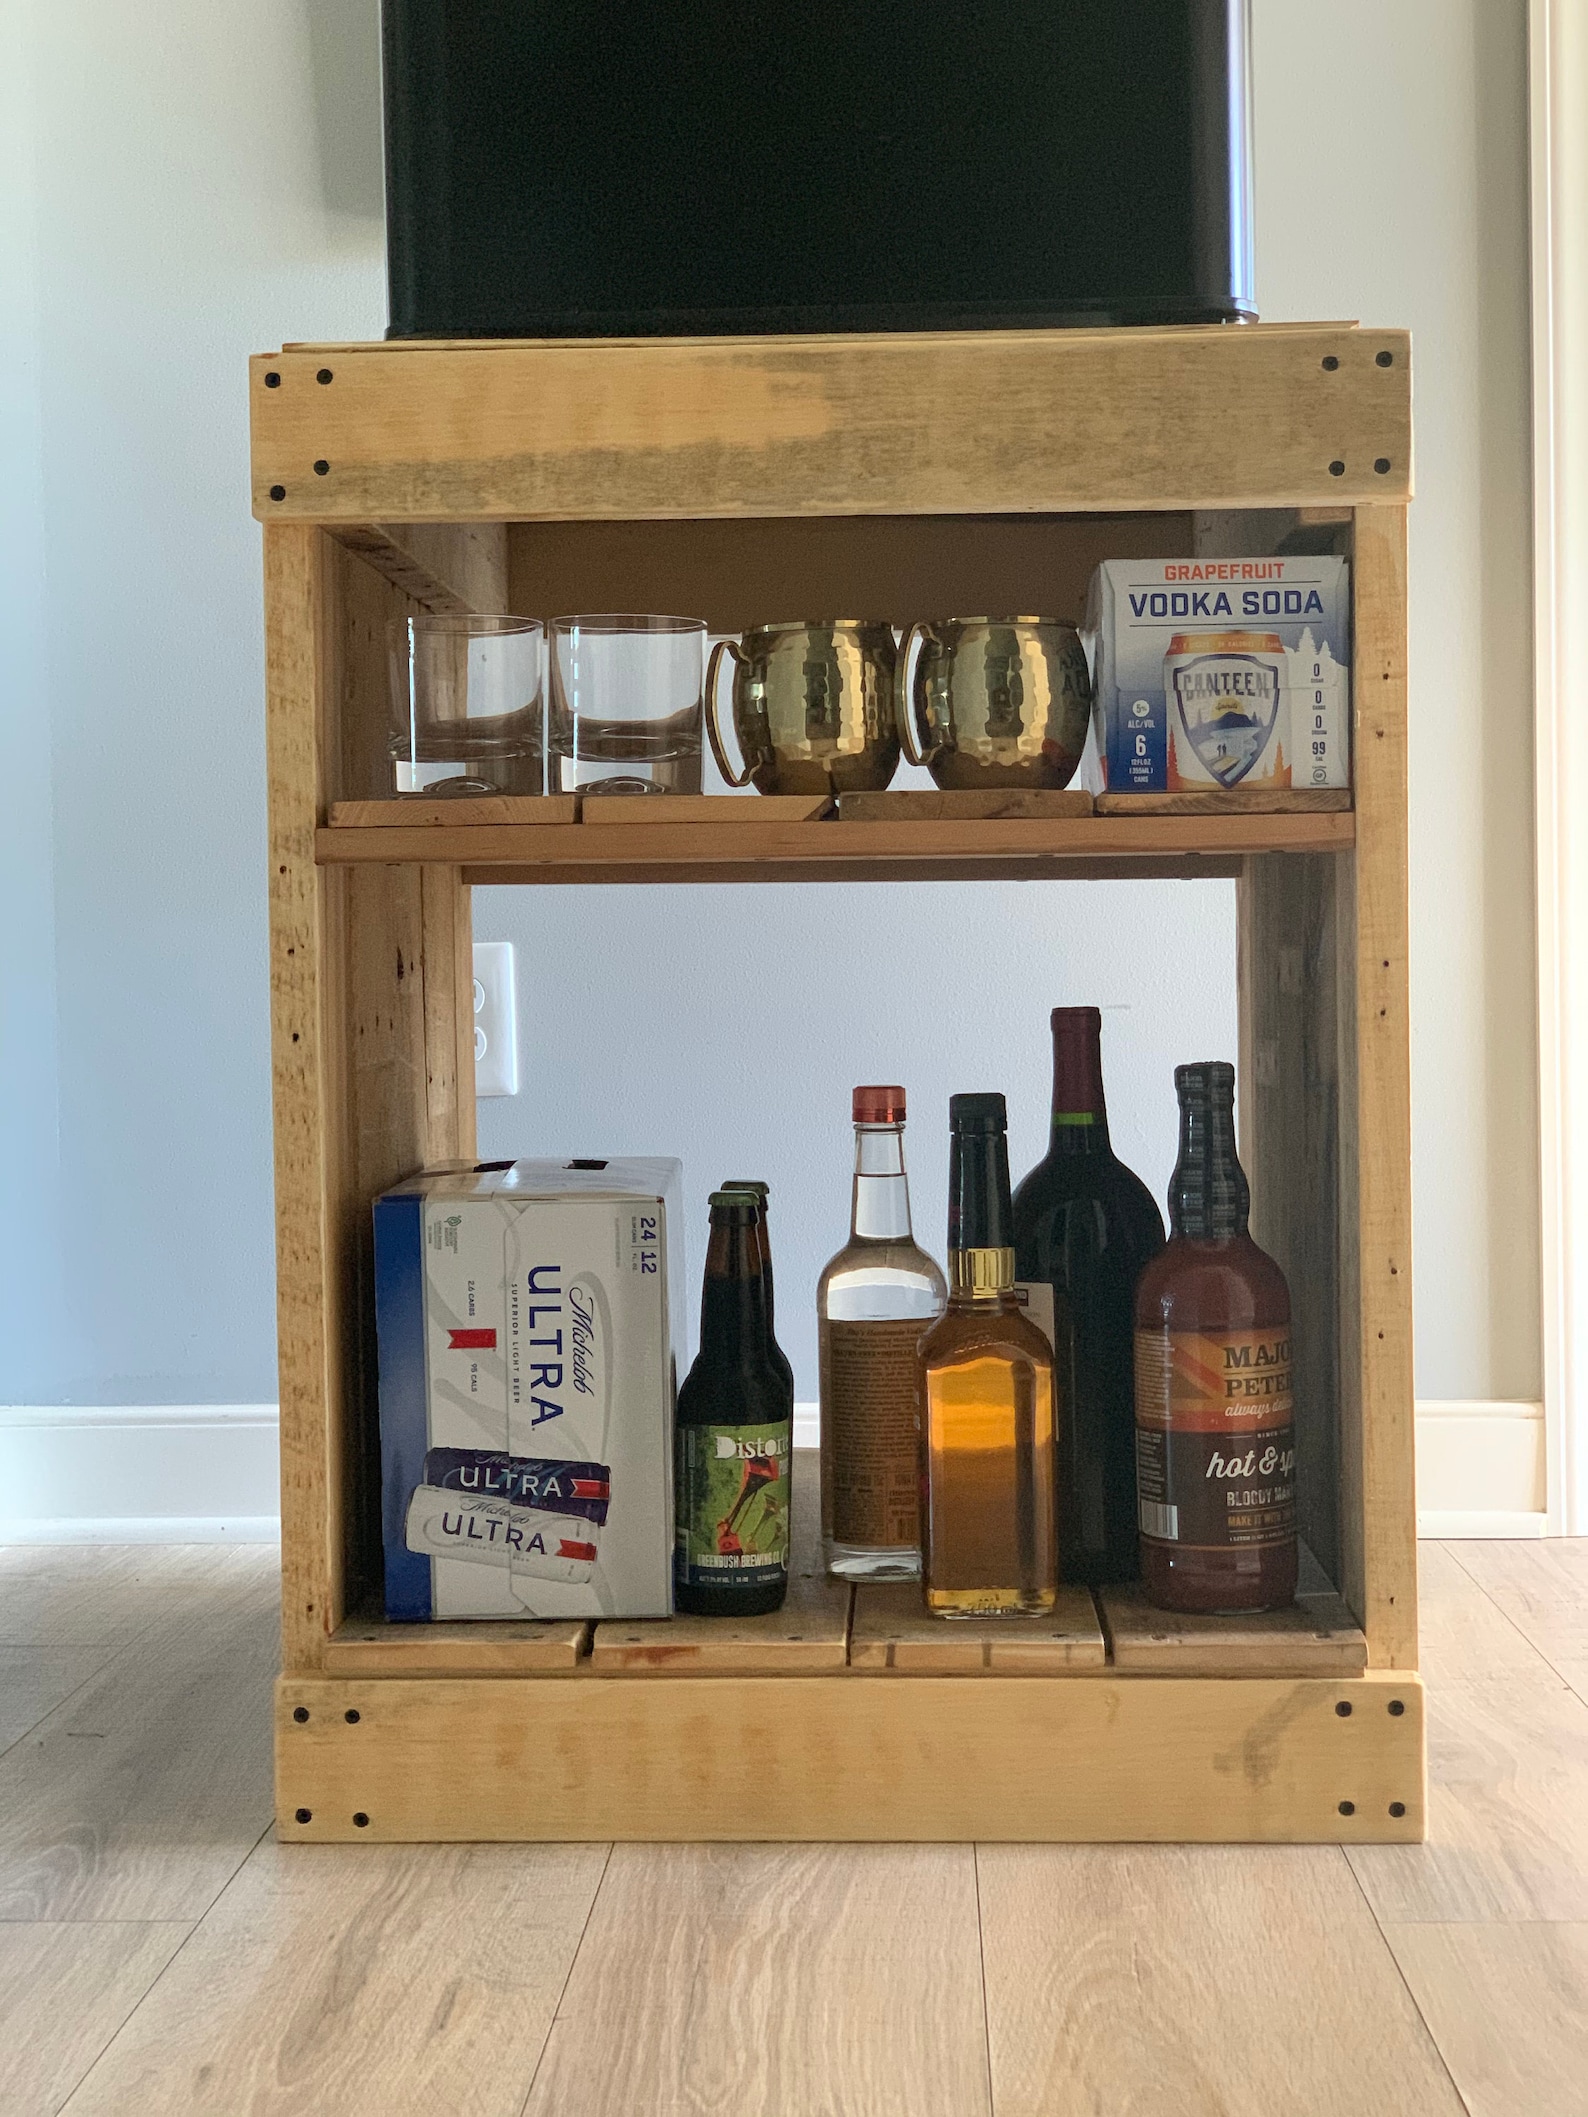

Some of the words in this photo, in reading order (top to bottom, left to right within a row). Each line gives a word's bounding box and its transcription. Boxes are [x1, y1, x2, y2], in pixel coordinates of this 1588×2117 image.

[1164, 563, 1285, 581] GRAPEFRUIT
[1128, 592, 1233, 617] VODKA
[1242, 590, 1324, 615] SODA
[1313, 662, 1320, 677] 0
[1182, 671, 1271, 703] CANTEEN
[1315, 690, 1322, 704] 0
[1127, 719, 1156, 729] ALC/VOL
[1315, 714, 1322, 729] 0
[1135, 734, 1147, 757] 6
[1311, 741, 1326, 755] 99
[1133, 775, 1149, 783] CANS
[640, 1217, 657, 1241] 24
[641, 1251, 657, 1274] 12
[511, 1283, 519, 1336] SUPERIOR
[527, 1265, 564, 1427] ULTRA
[569, 1286, 595, 1397] Michelob
[512, 1341, 520, 1372] LIGHT
[470, 1374, 478, 1393] CALS
[512, 1377, 520, 1404] BEER
[1224, 1402, 1270, 1419] always
[1205, 1450, 1256, 1478] hot
[1258, 1446, 1279, 1475] &
[459, 1465, 562, 1498] ULTRA
[1226, 1488, 1272, 1507] BLOODY
[1228, 1514, 1252, 1527] MAKE
[1254, 1513, 1262, 1526] IT
[442, 1511, 547, 1555] ULTRA
[741, 1552, 772, 1568] BREWING
